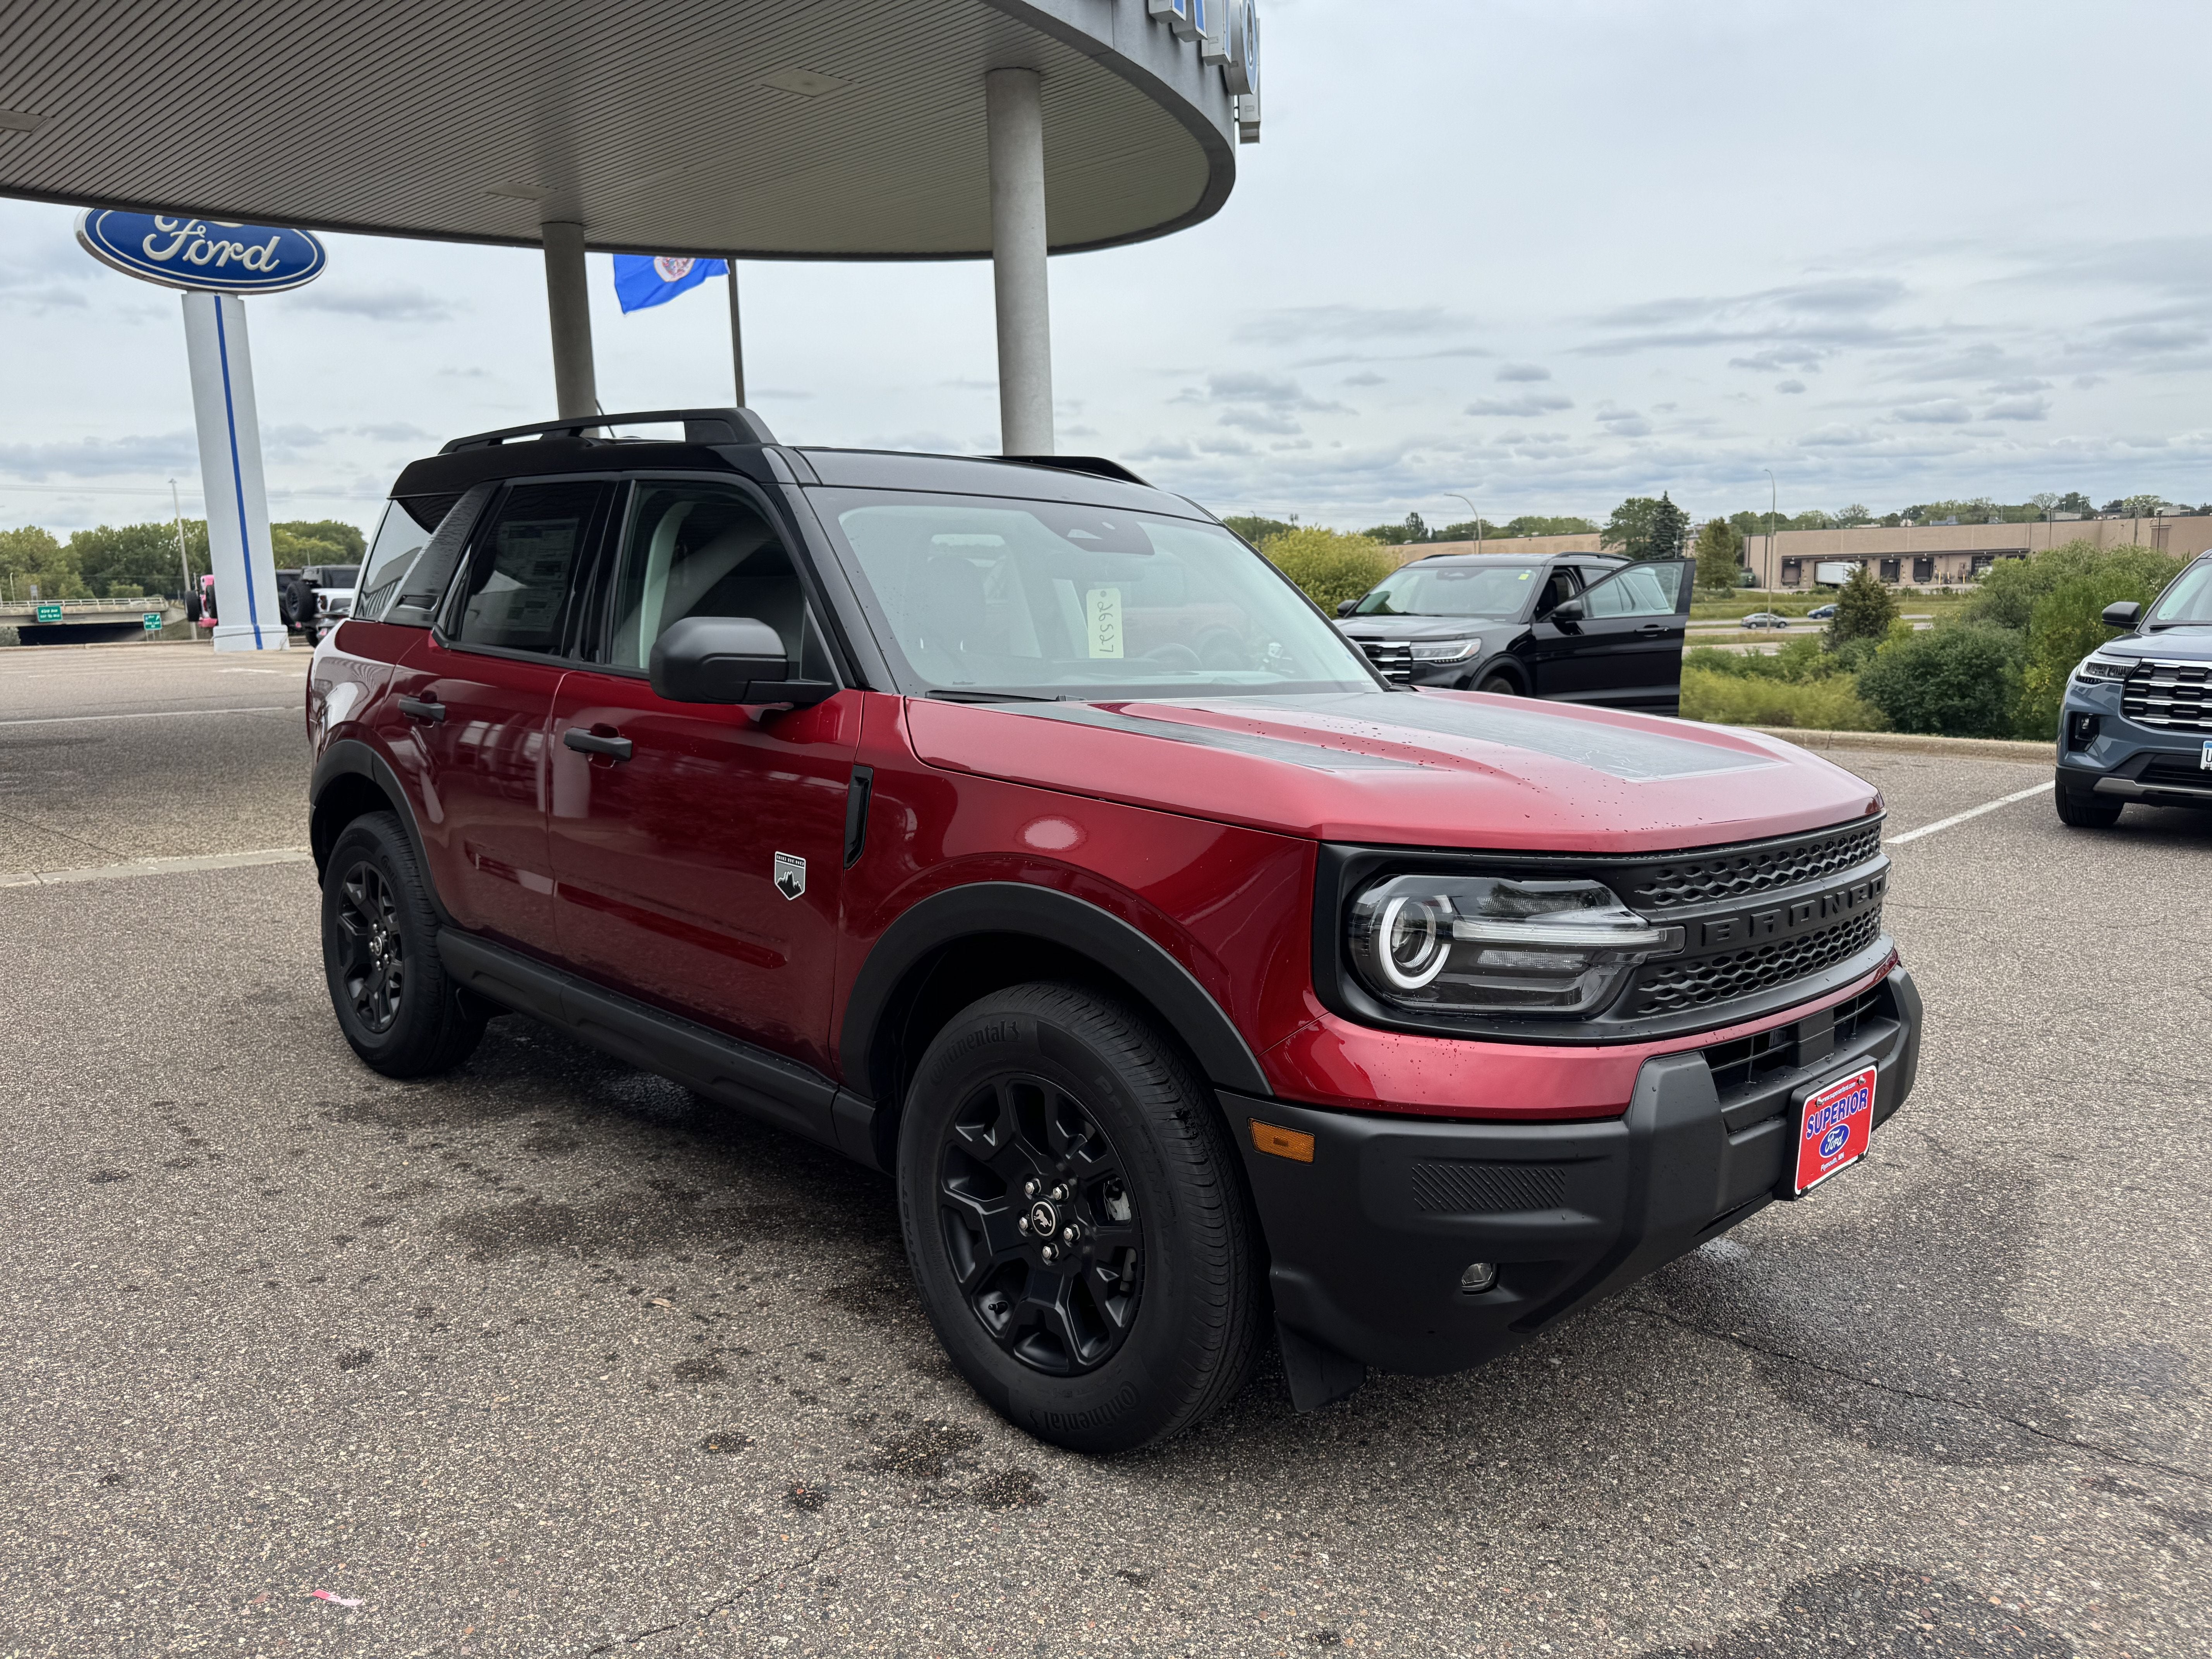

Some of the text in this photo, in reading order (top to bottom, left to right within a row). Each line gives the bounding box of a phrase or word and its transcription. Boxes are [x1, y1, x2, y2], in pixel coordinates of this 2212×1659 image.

[143, 215, 280, 272] Ford
[1097, 601, 1114, 653] 26527
[1701, 874, 1884, 946] BRONCO
[930, 1020, 1007, 1086] Continental
[1806, 1087, 1869, 1140] SUPERIOR
[1825, 1129, 1844, 1153] Ford
[1043, 1381, 1141, 1432] Continental
